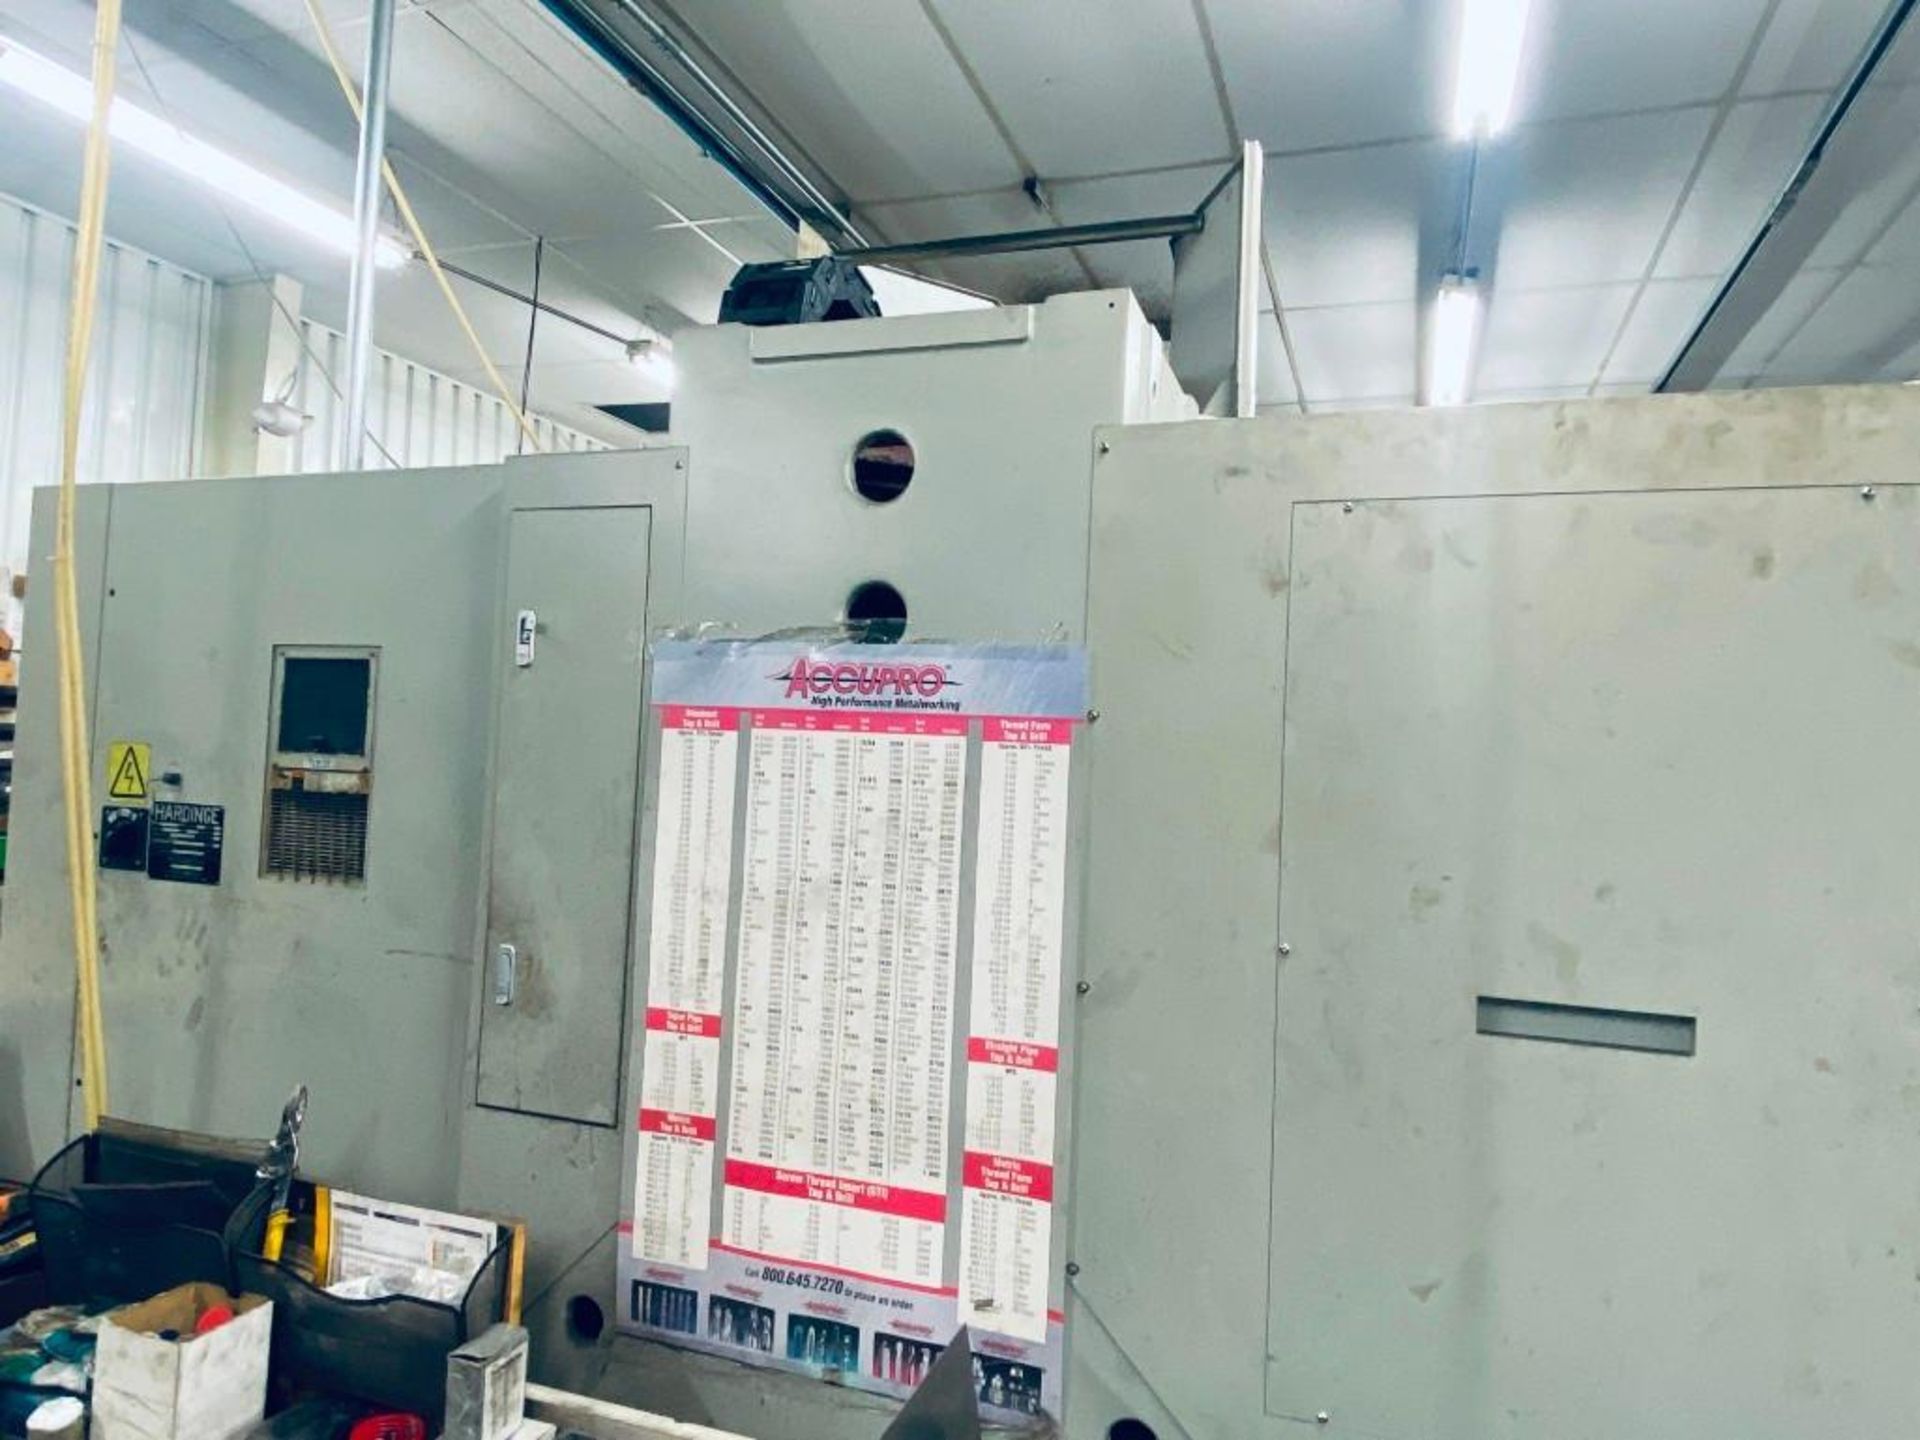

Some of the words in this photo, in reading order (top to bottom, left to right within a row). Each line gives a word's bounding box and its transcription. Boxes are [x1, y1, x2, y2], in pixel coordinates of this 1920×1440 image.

[784, 656, 945, 698] ACCUPRO
[811, 696, 832, 709] High
[834, 697, 893, 708] Performance
[895, 698, 961, 711] Metalworking
[154, 804, 220, 824] HARDINGE
[806, 1173, 836, 1188] Thread
[761, 1266, 844, 1295] 800.645.7270
